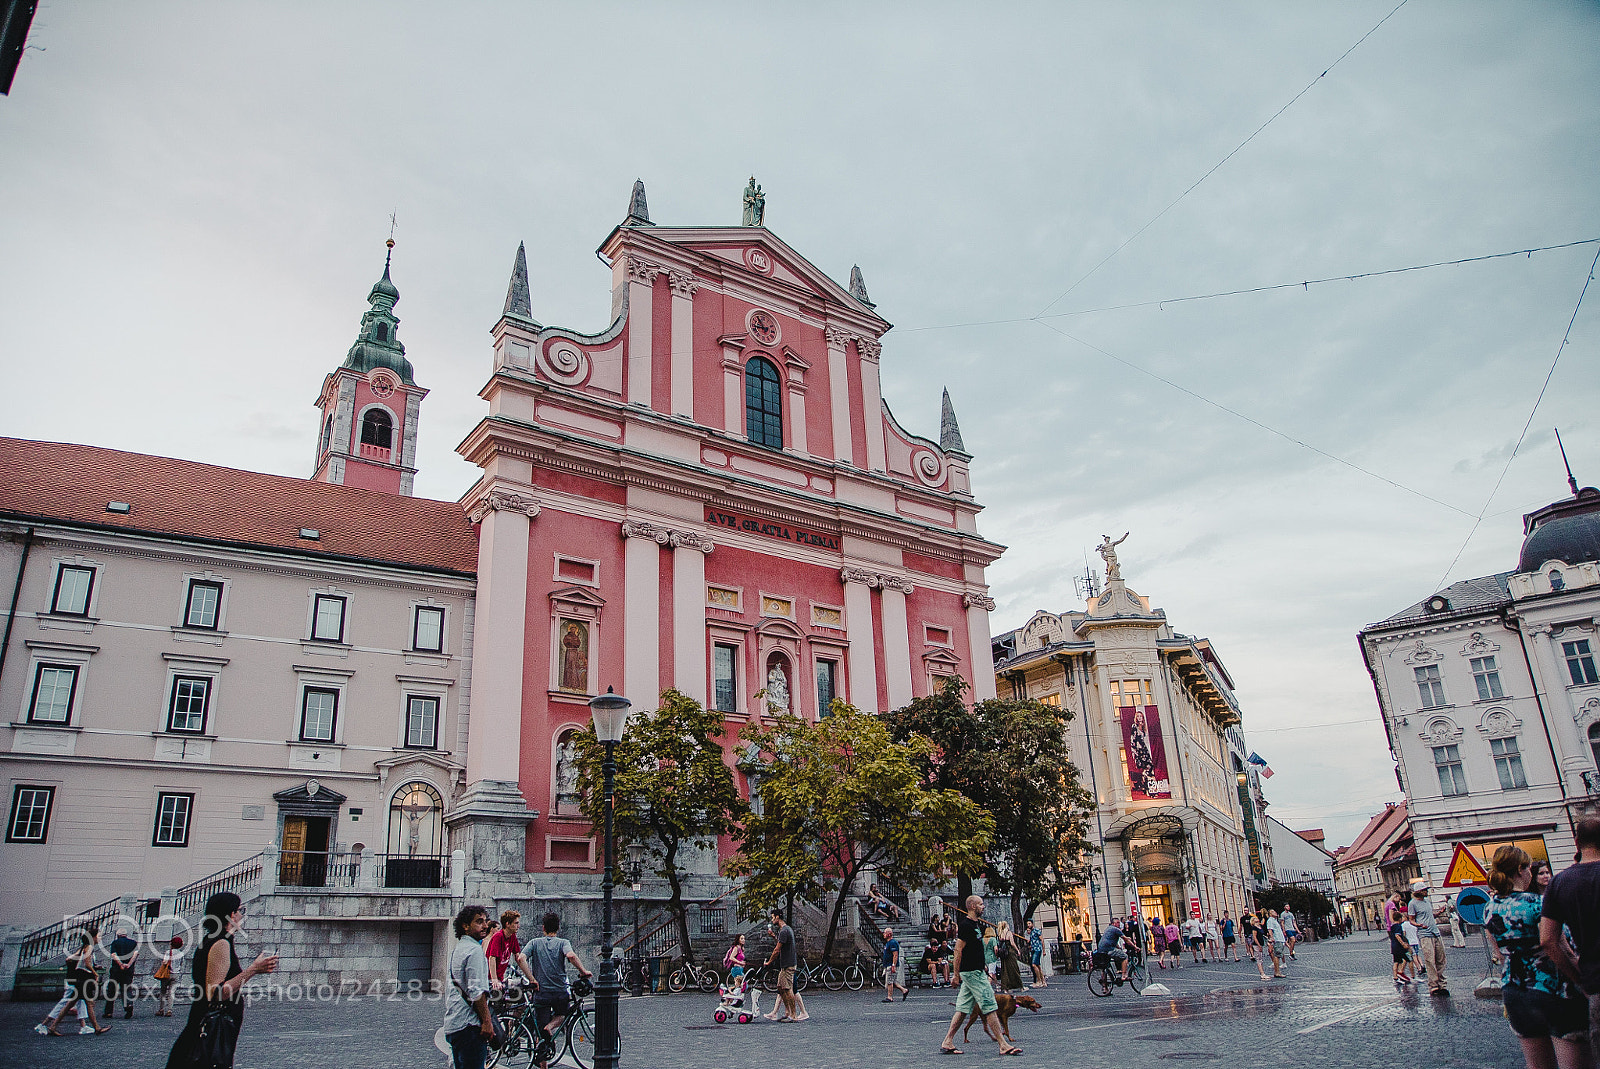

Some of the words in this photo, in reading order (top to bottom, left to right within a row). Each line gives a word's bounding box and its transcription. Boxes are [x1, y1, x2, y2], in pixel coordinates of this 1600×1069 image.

[742, 518, 791, 540] GRATIA
[796, 530, 839, 550] PLENA!
[1241, 779, 1254, 829] EMPORIUM
[1249, 831, 1262, 875] GALERIJA
